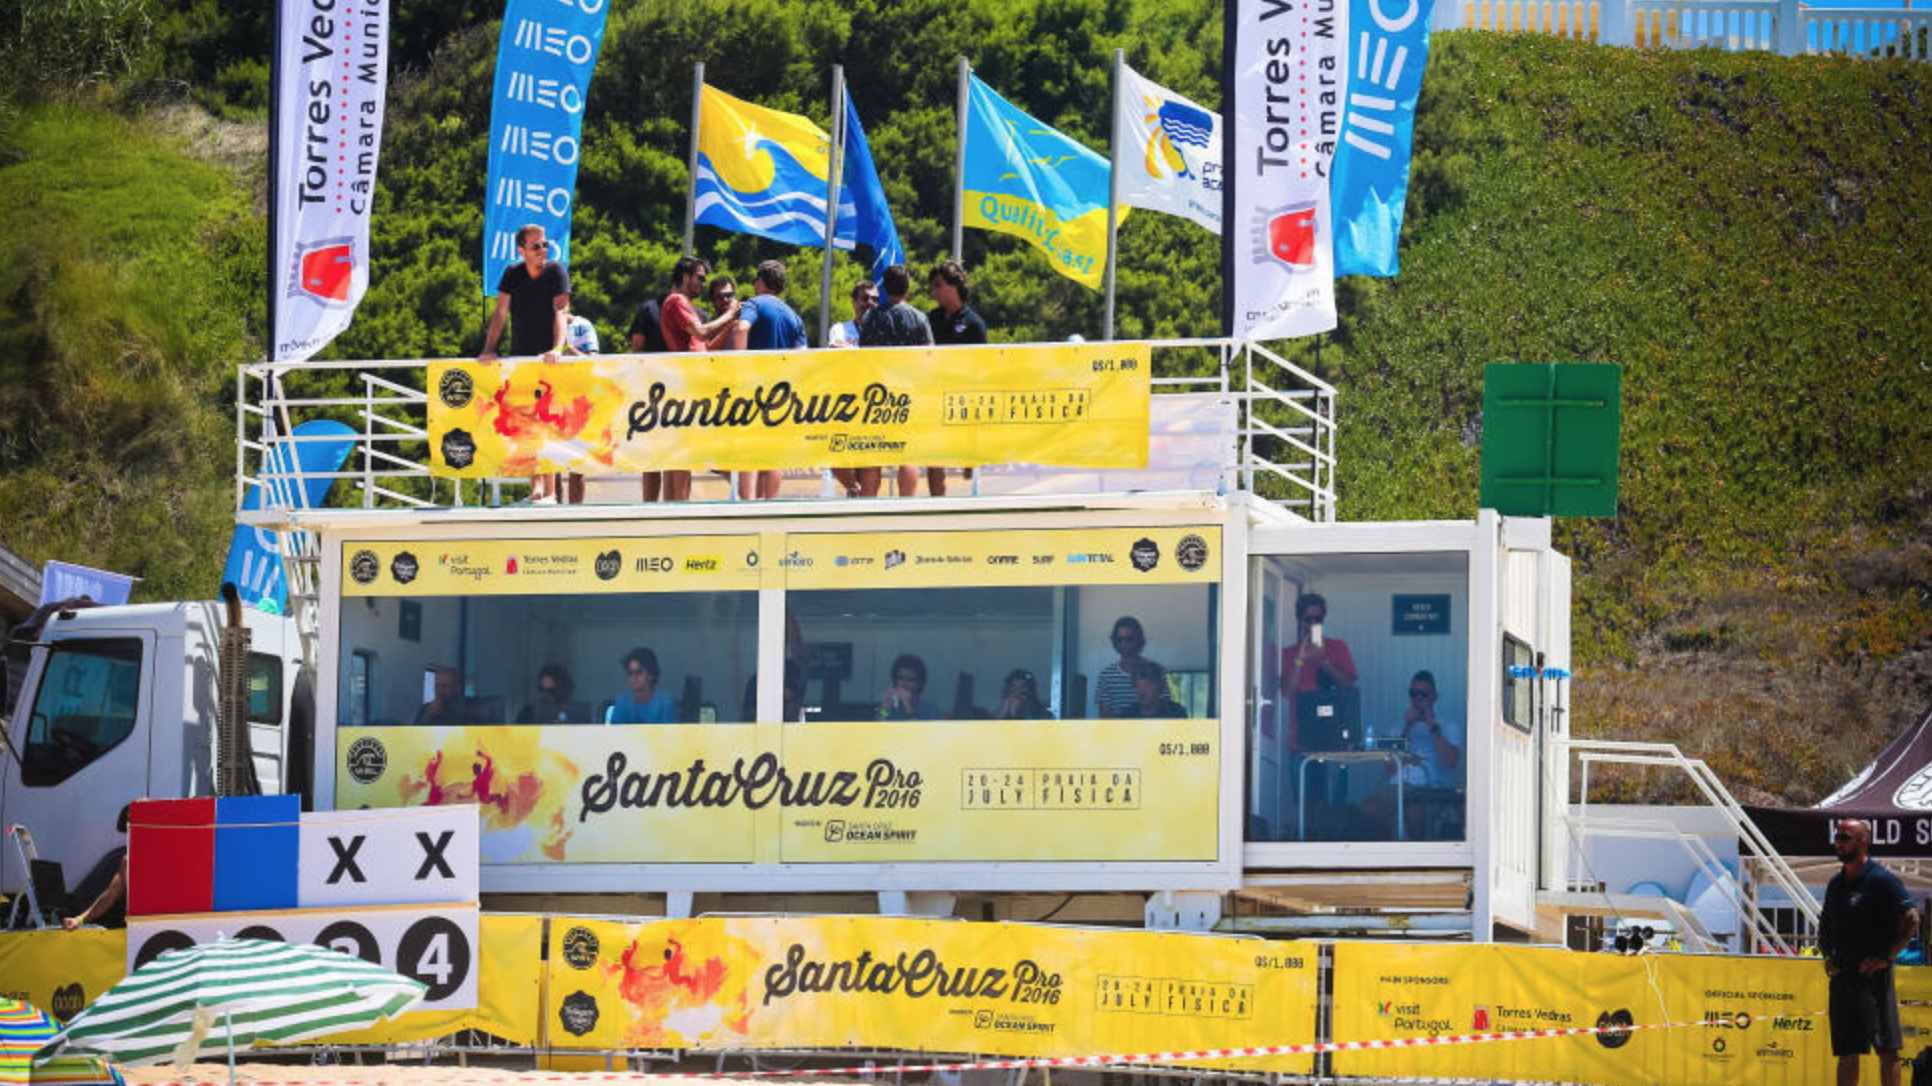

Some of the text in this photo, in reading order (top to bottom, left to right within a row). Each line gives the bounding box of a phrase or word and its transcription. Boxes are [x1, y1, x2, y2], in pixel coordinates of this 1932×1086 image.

[514, 19, 592, 64] MEO
[507, 71, 582, 113] MEO
[1257, 37, 1290, 177] Torres
[300, 79, 332, 211] Torres
[502, 124, 578, 165] MEO
[350, 100, 376, 216] Câmara
[496, 177, 570, 217] MEO
[862, 383, 911, 424] Pro
[871, 408, 910, 425] 2016
[636, 557, 674, 572] MEO
[685, 558, 717, 572] Hertz
[863, 758, 924, 808] Pro
[1042, 774, 1132, 785] PRAIA DA
[877, 788, 921, 808] 2016
[968, 788, 1023, 804] JULY
[846, 830, 917, 840] OCEAN SPIRIT
[326, 830, 456, 884] X X
[416, 932, 453, 985] 4
[1011, 959, 1063, 1002] Pro
[1020, 986, 1062, 1005] 2016
[1396, 1003, 1420, 1015] visit
[1496, 1005, 1572, 1022] Torres Vedras
[1394, 1017, 1453, 1038] Portugal
[1704, 1011, 1751, 1030] MEO
[1772, 1017, 1814, 1031] Hertz
